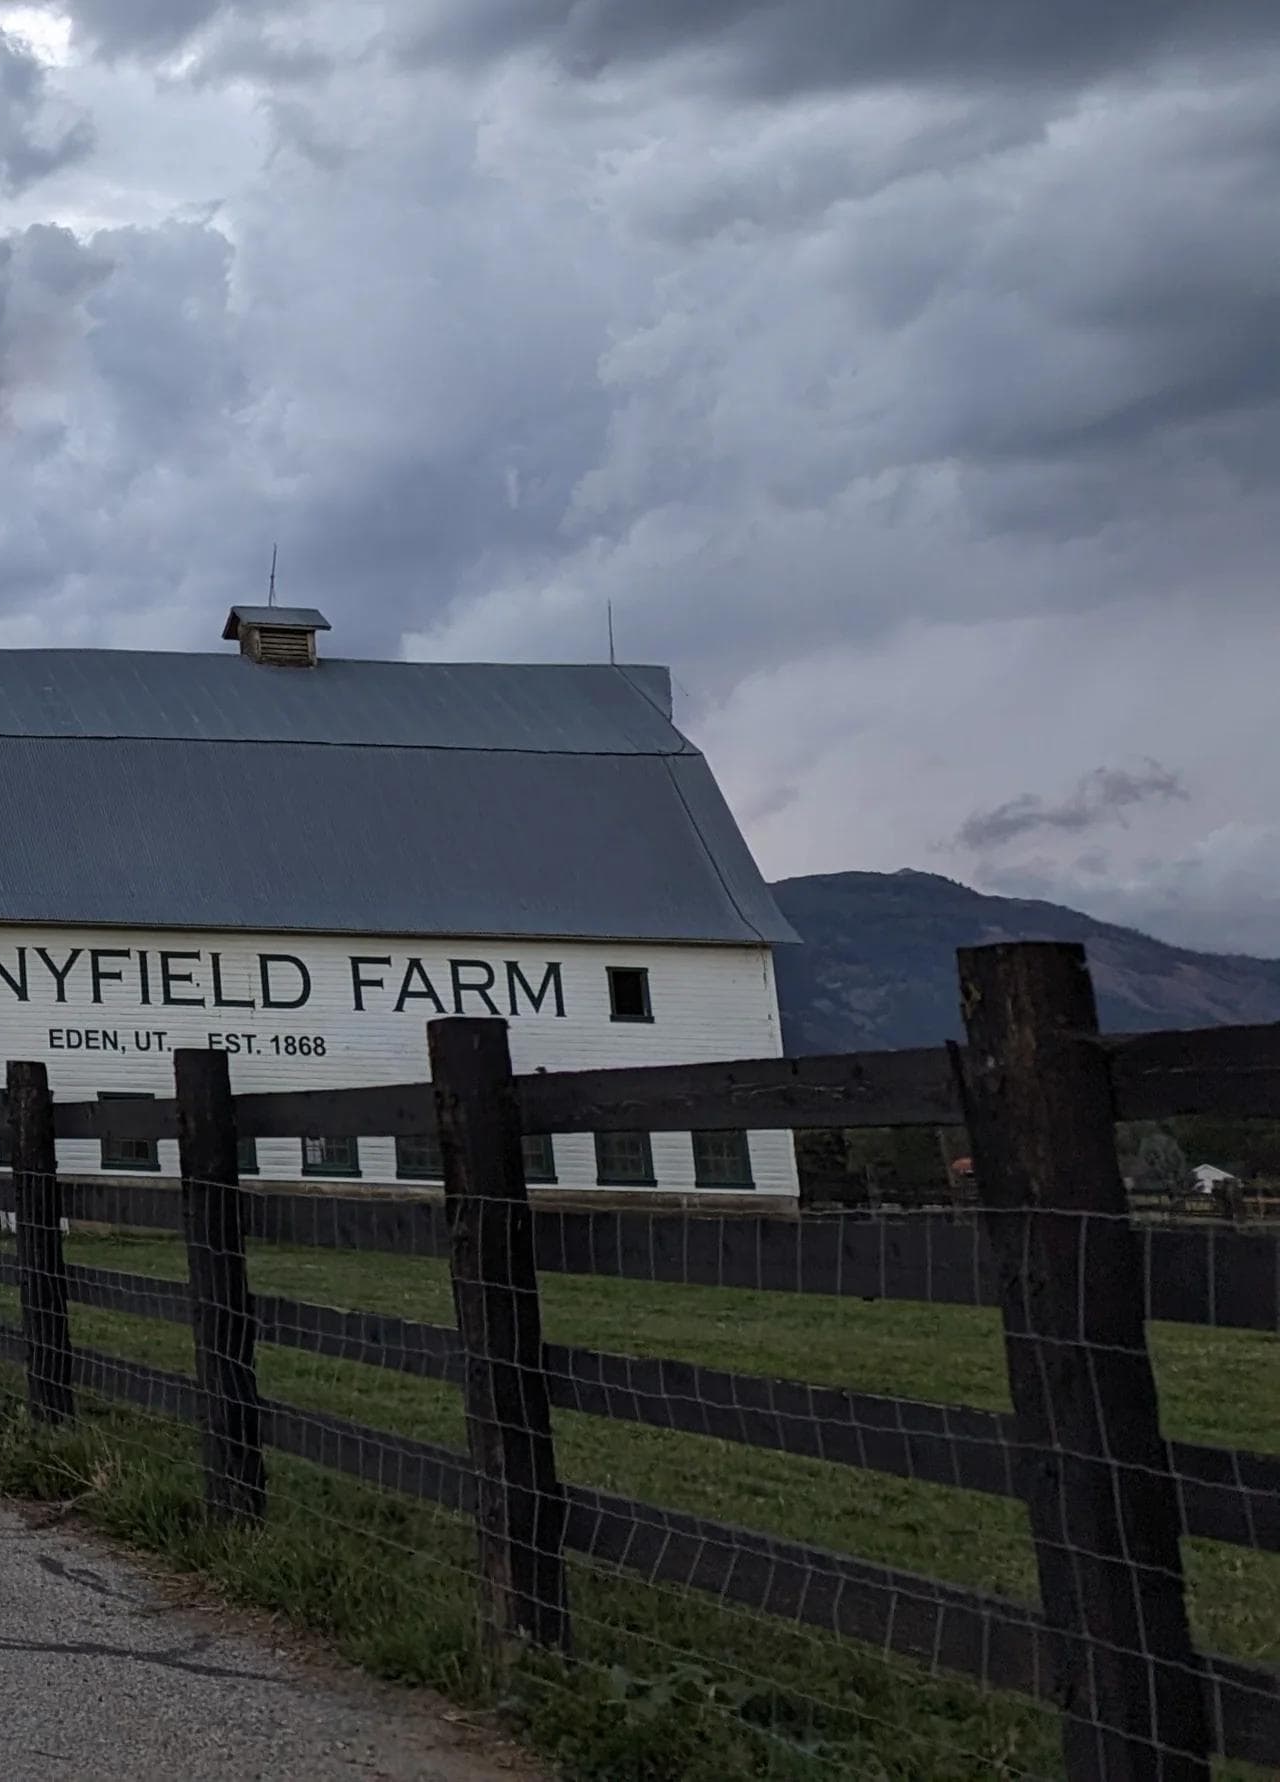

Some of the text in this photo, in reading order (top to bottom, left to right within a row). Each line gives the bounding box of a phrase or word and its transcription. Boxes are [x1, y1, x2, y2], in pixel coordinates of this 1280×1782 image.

[348, 955, 568, 1018] FARM
[49, 1029, 127, 1054] EDEN,
[208, 1033, 262, 1055] EST.
[270, 1035, 327, 1057] 1868
